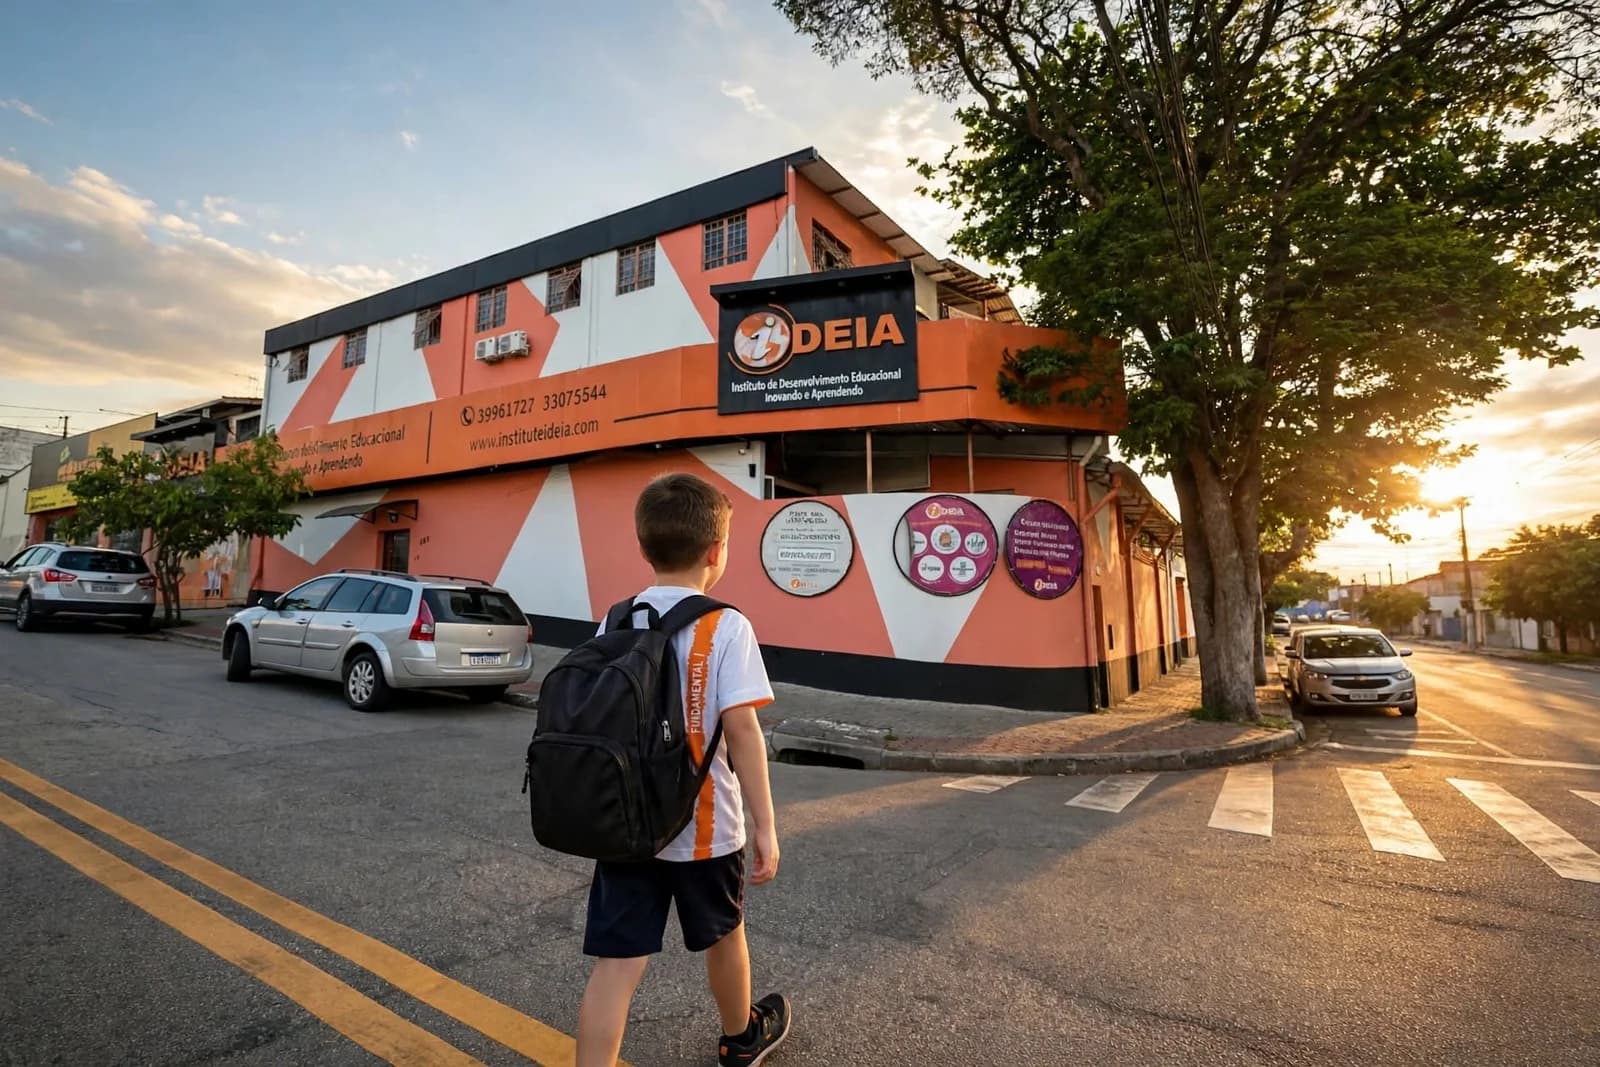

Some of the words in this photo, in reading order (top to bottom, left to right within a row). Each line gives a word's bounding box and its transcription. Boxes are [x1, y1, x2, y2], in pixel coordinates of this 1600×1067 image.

[731, 380, 766, 393] Instituto
[767, 378, 778, 390] de
[779, 374, 849, 389] Desenvolvimento
[851, 367, 902, 383] Educacional
[477, 398, 535, 424] 39961727
[543, 384, 607, 411] 33075544
[765, 389, 803, 403] Inovando
[804, 391, 810, 400] e
[811, 384, 864, 401] Aprendendo
[351, 424, 405, 449] Educacional
